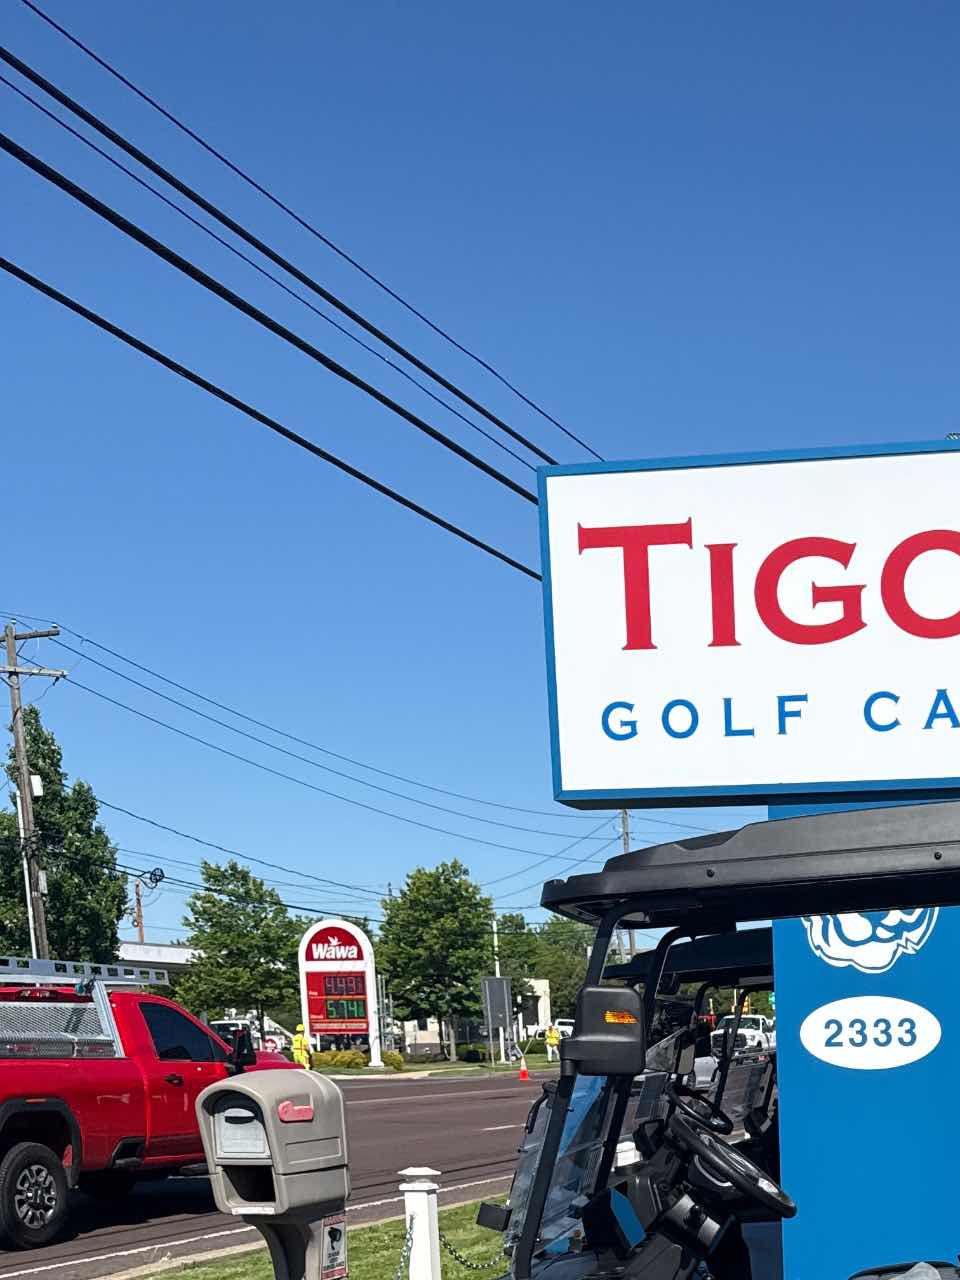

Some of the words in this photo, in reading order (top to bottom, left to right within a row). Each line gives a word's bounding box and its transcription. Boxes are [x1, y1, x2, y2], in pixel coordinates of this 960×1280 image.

[602, 694, 808, 741] GOLF
[312, 943, 357, 959] Wawa
[825, 1018, 916, 1047] 2333
